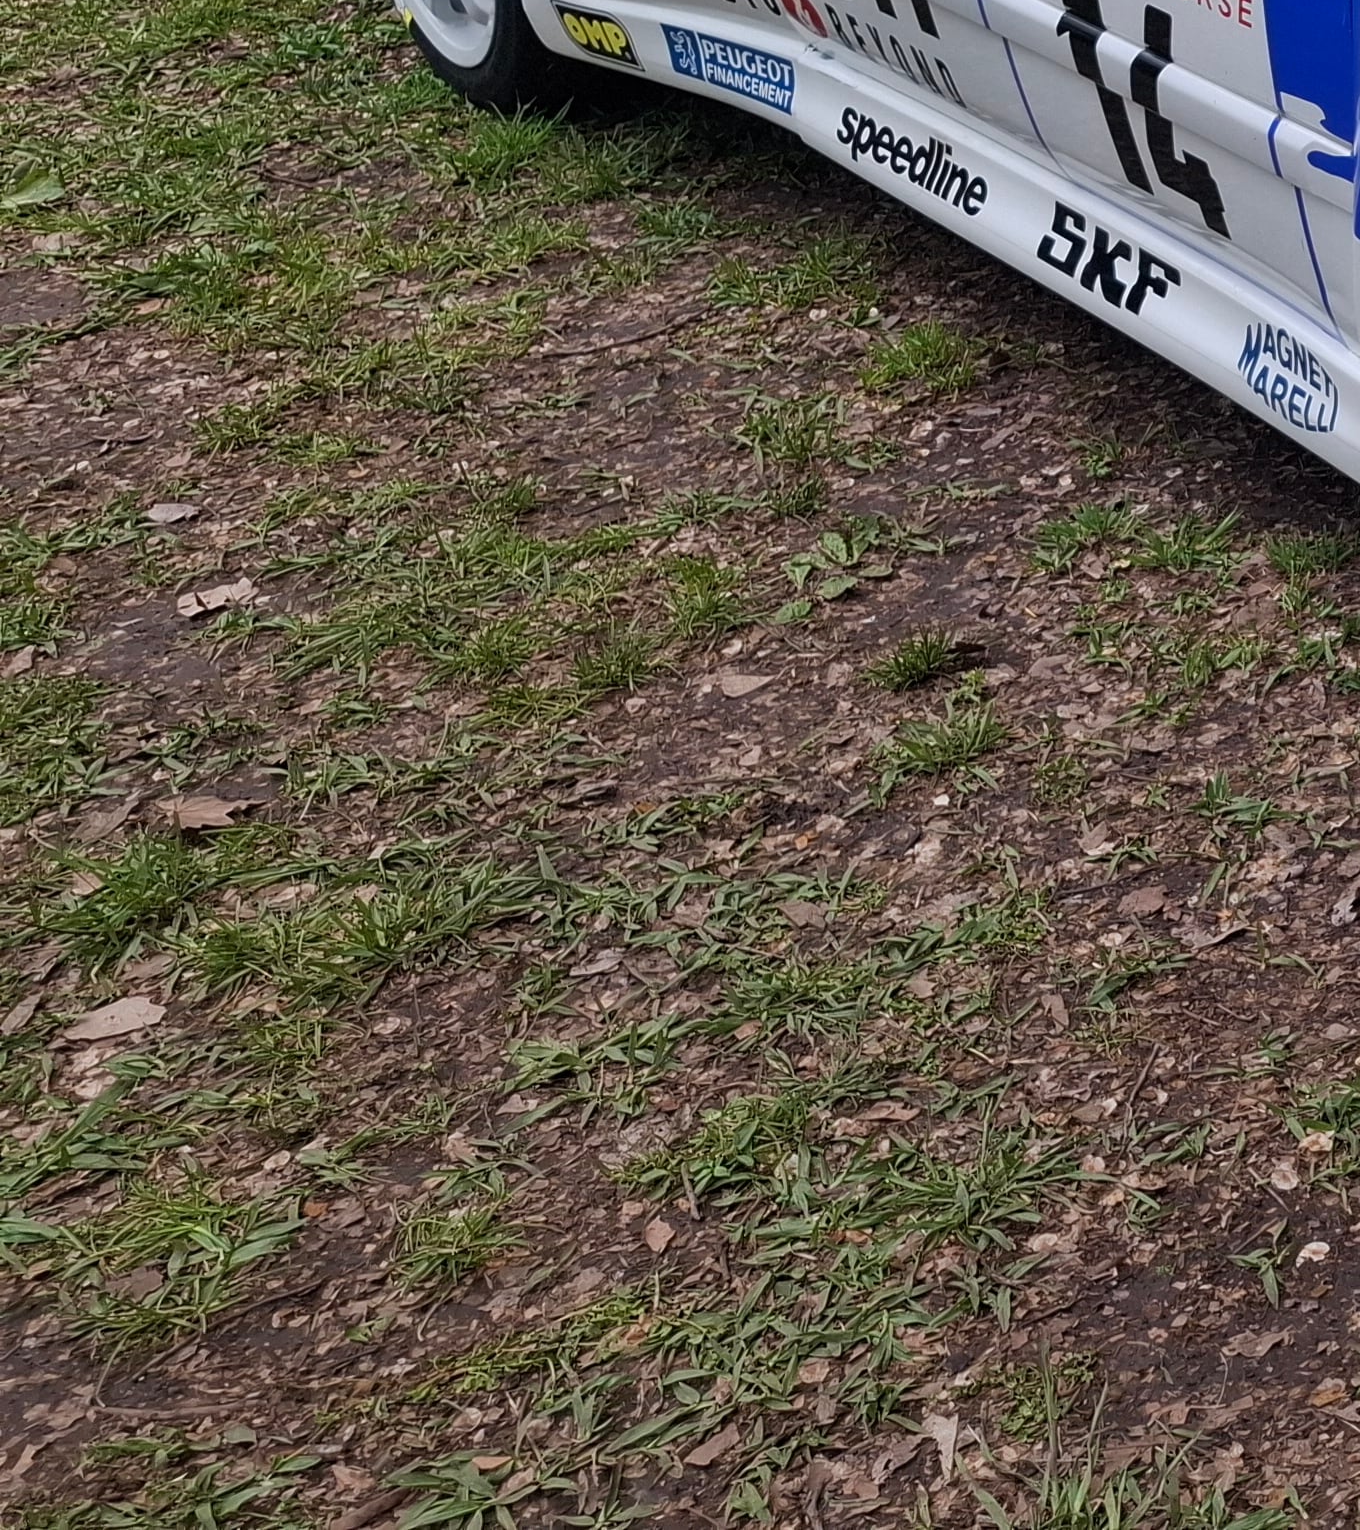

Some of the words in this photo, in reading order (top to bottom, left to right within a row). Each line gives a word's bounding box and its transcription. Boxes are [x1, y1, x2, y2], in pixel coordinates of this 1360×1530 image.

[562, 12, 627, 56] OMP
[701, 38, 793, 87] PEUGEOT
[824, 2, 968, 109] BEYOND
[706, 63, 792, 110] FINANCEMENT
[836, 106, 988, 217] speedline
[1036, 200, 1182, 317] SKF
[1238, 362, 1339, 433] MARELLI
